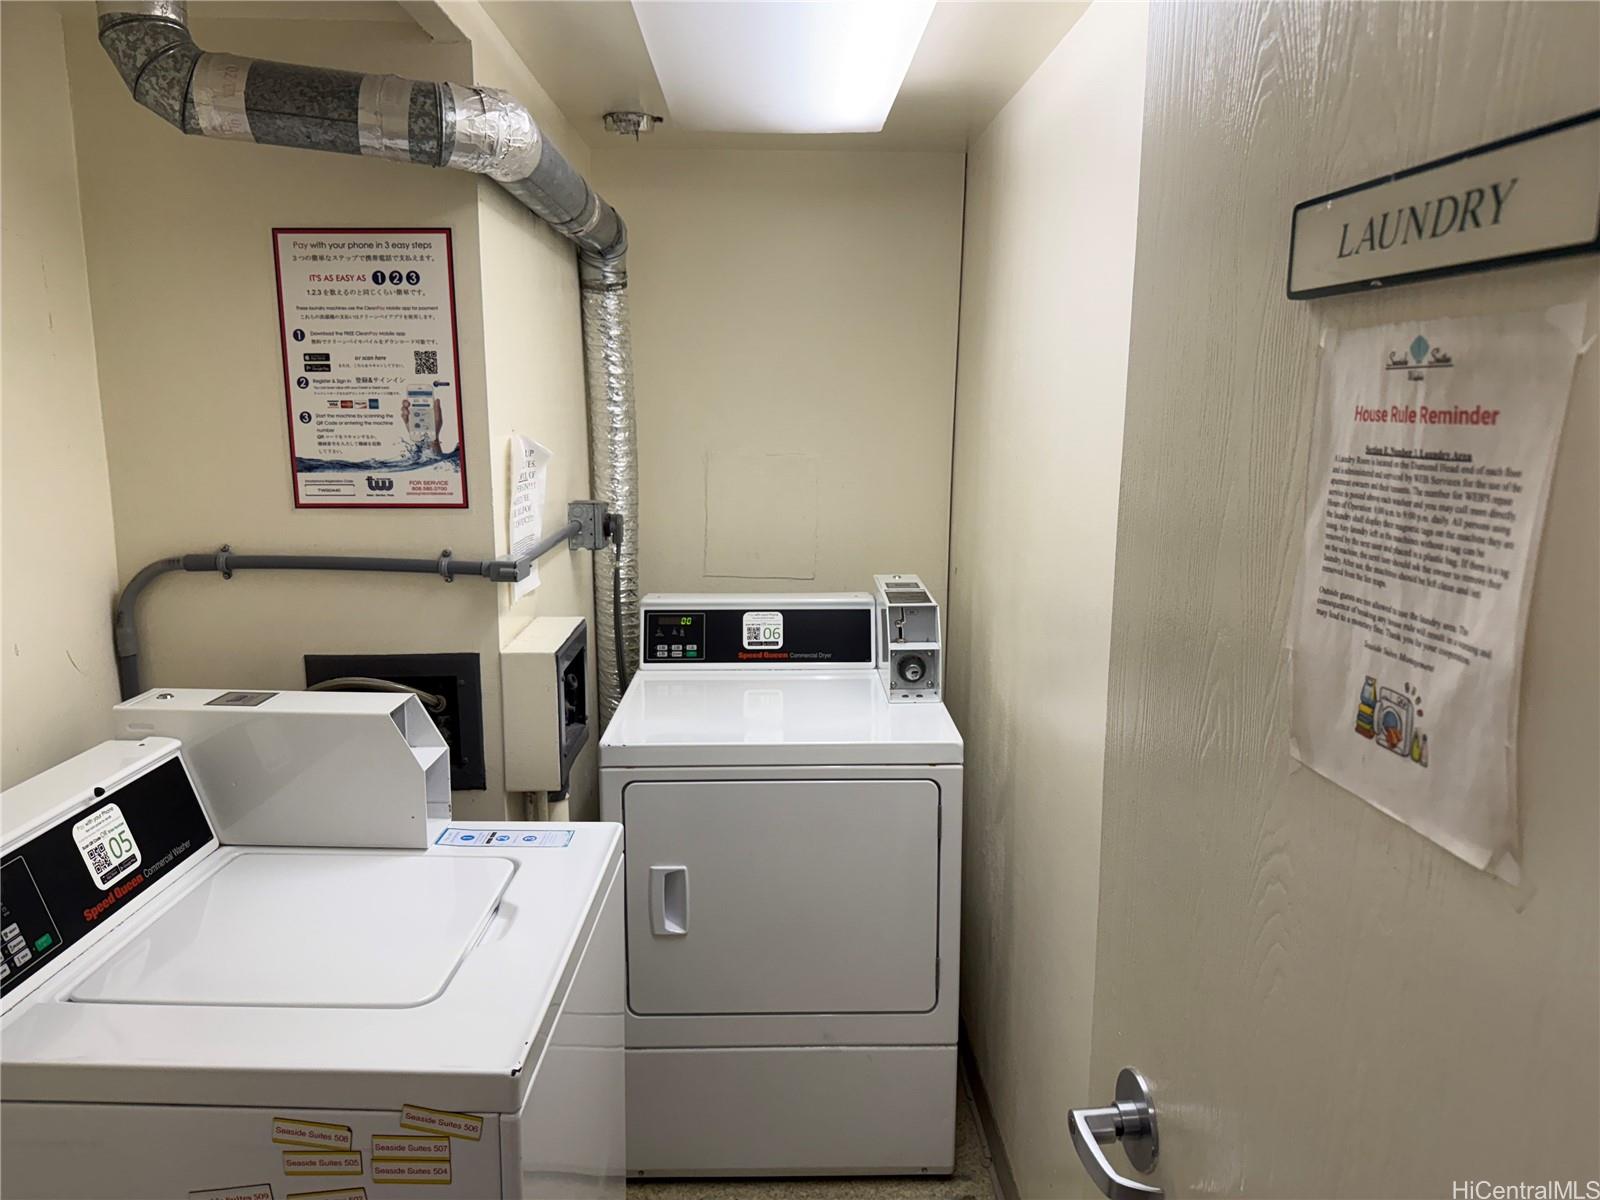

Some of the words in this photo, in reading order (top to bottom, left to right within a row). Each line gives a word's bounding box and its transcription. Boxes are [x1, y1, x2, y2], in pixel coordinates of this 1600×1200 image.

[1337, 177, 1519, 259] LAUNDRY
[293, 241, 308, 250] Pay
[310, 241, 326, 249] with
[347, 241, 374, 250] phone
[376, 241, 382, 249] in
[385, 241, 390, 249] 3
[391, 242, 410, 250] easy
[411, 241, 432, 250] steps
[324, 274, 334, 282] AS
[336, 274, 354, 282] EASY
[357, 274, 366, 282] AS
[1354, 405, 1388, 423] House
[1391, 405, 1417, 424] Rule
[1420, 405, 1500, 426] Reminder
[763, 627, 781, 640] 06
[738, 651, 763, 659] Speed
[763, 651, 788, 659] Queen
[109, 830, 133, 859] 05
[83, 891, 117, 921] Speed
[113, 873, 145, 899] Queen
[143, 850, 174, 878] Commercial
[171, 839, 192, 857] Washer
[405, 1112, 436, 1125] Seaside
[438, 1118, 462, 1130] Suites
[463, 1122, 479, 1133] 506
[275, 1126, 307, 1137] Seaside
[308, 1130, 332, 1141] Suites
[374, 1143, 406, 1152] Seaside
[407, 1144, 432, 1152] Suites
[433, 1145, 448, 1153] 507
[286, 1159, 317, 1167] Seaside
[319, 1159, 343, 1167] Suites
[374, 1167, 406, 1175] Seaside
[407, 1167, 431, 1175] Suites
[432, 1167, 448, 1176] 504
